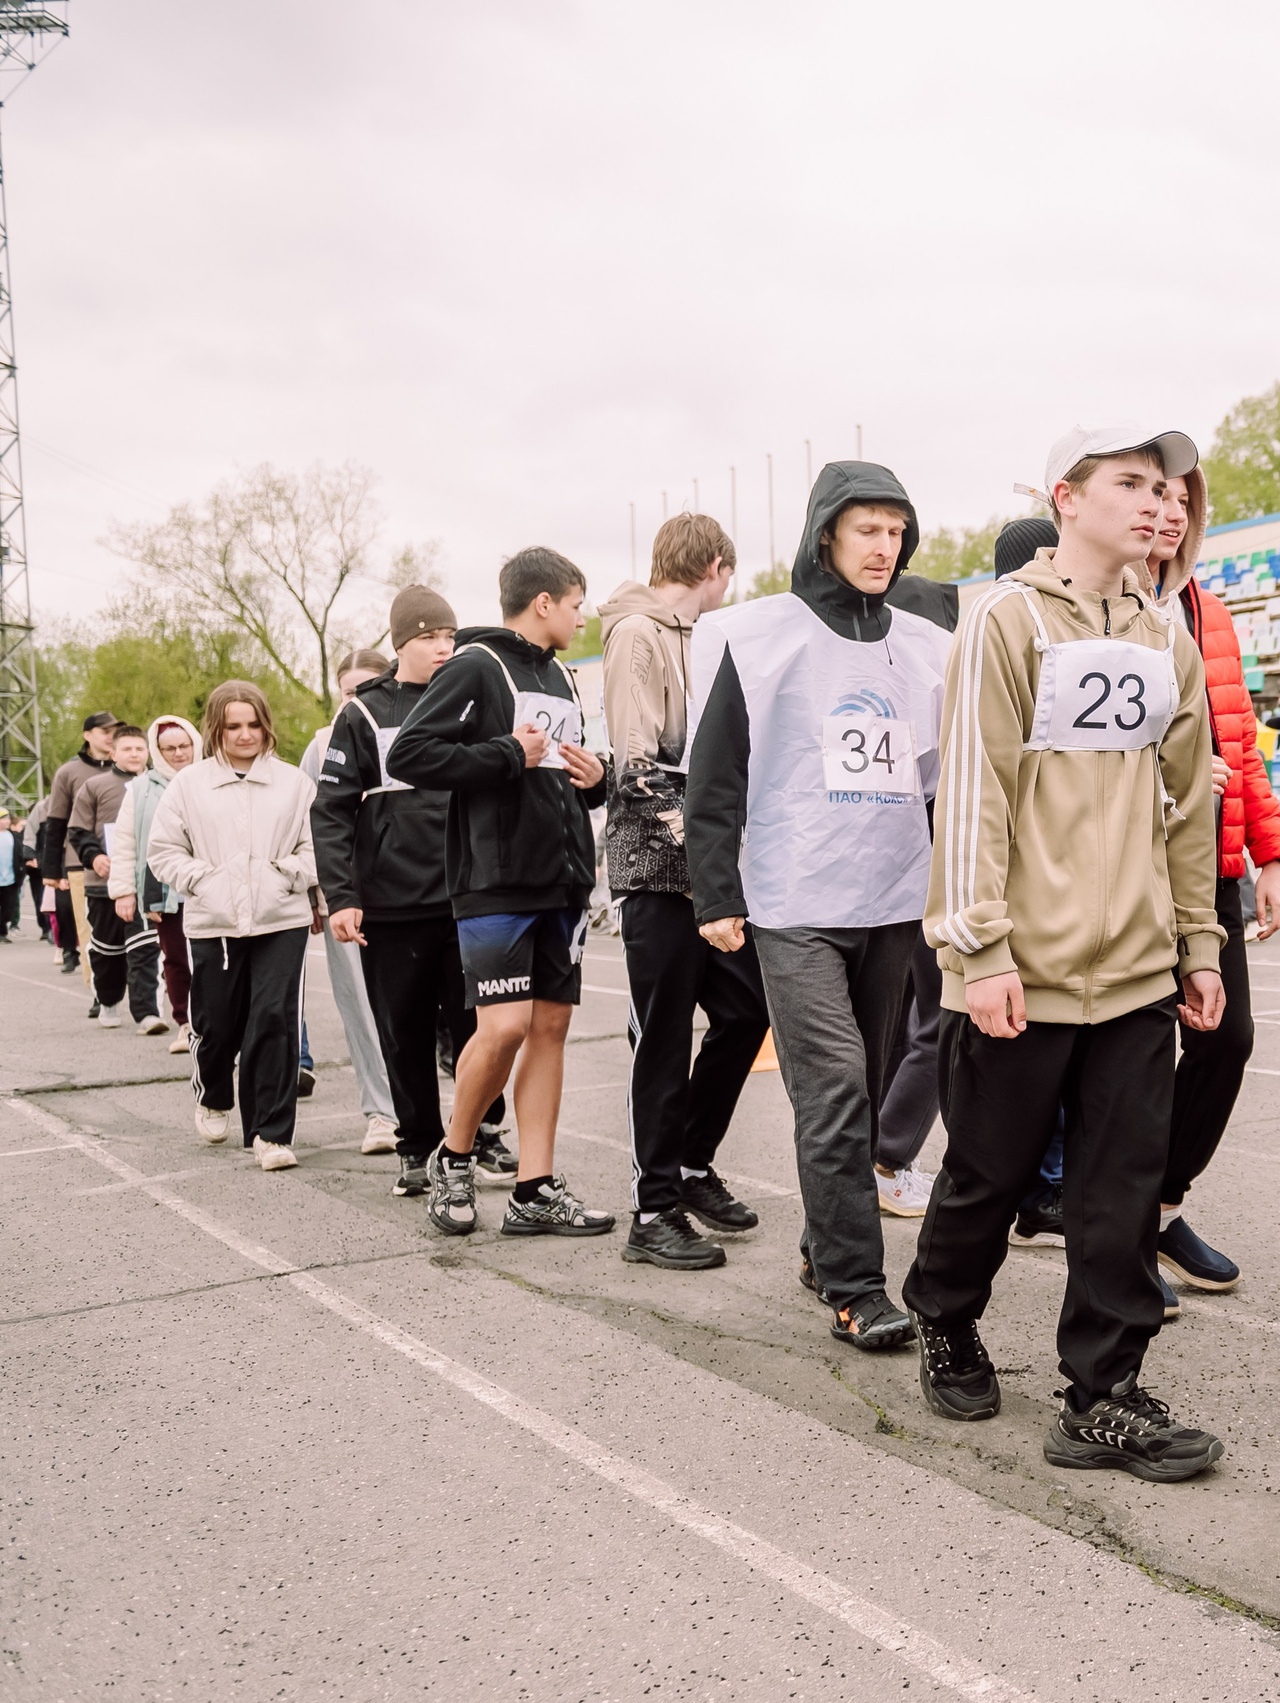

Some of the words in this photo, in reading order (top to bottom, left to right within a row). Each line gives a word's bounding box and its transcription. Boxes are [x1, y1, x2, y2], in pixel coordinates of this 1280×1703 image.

[629, 634, 654, 686] NIKE
[1072, 672, 1147, 731] 23
[841, 728, 896, 775] 34
[829, 792, 862, 804] ПАО
[477, 976, 531, 997] MANTO
